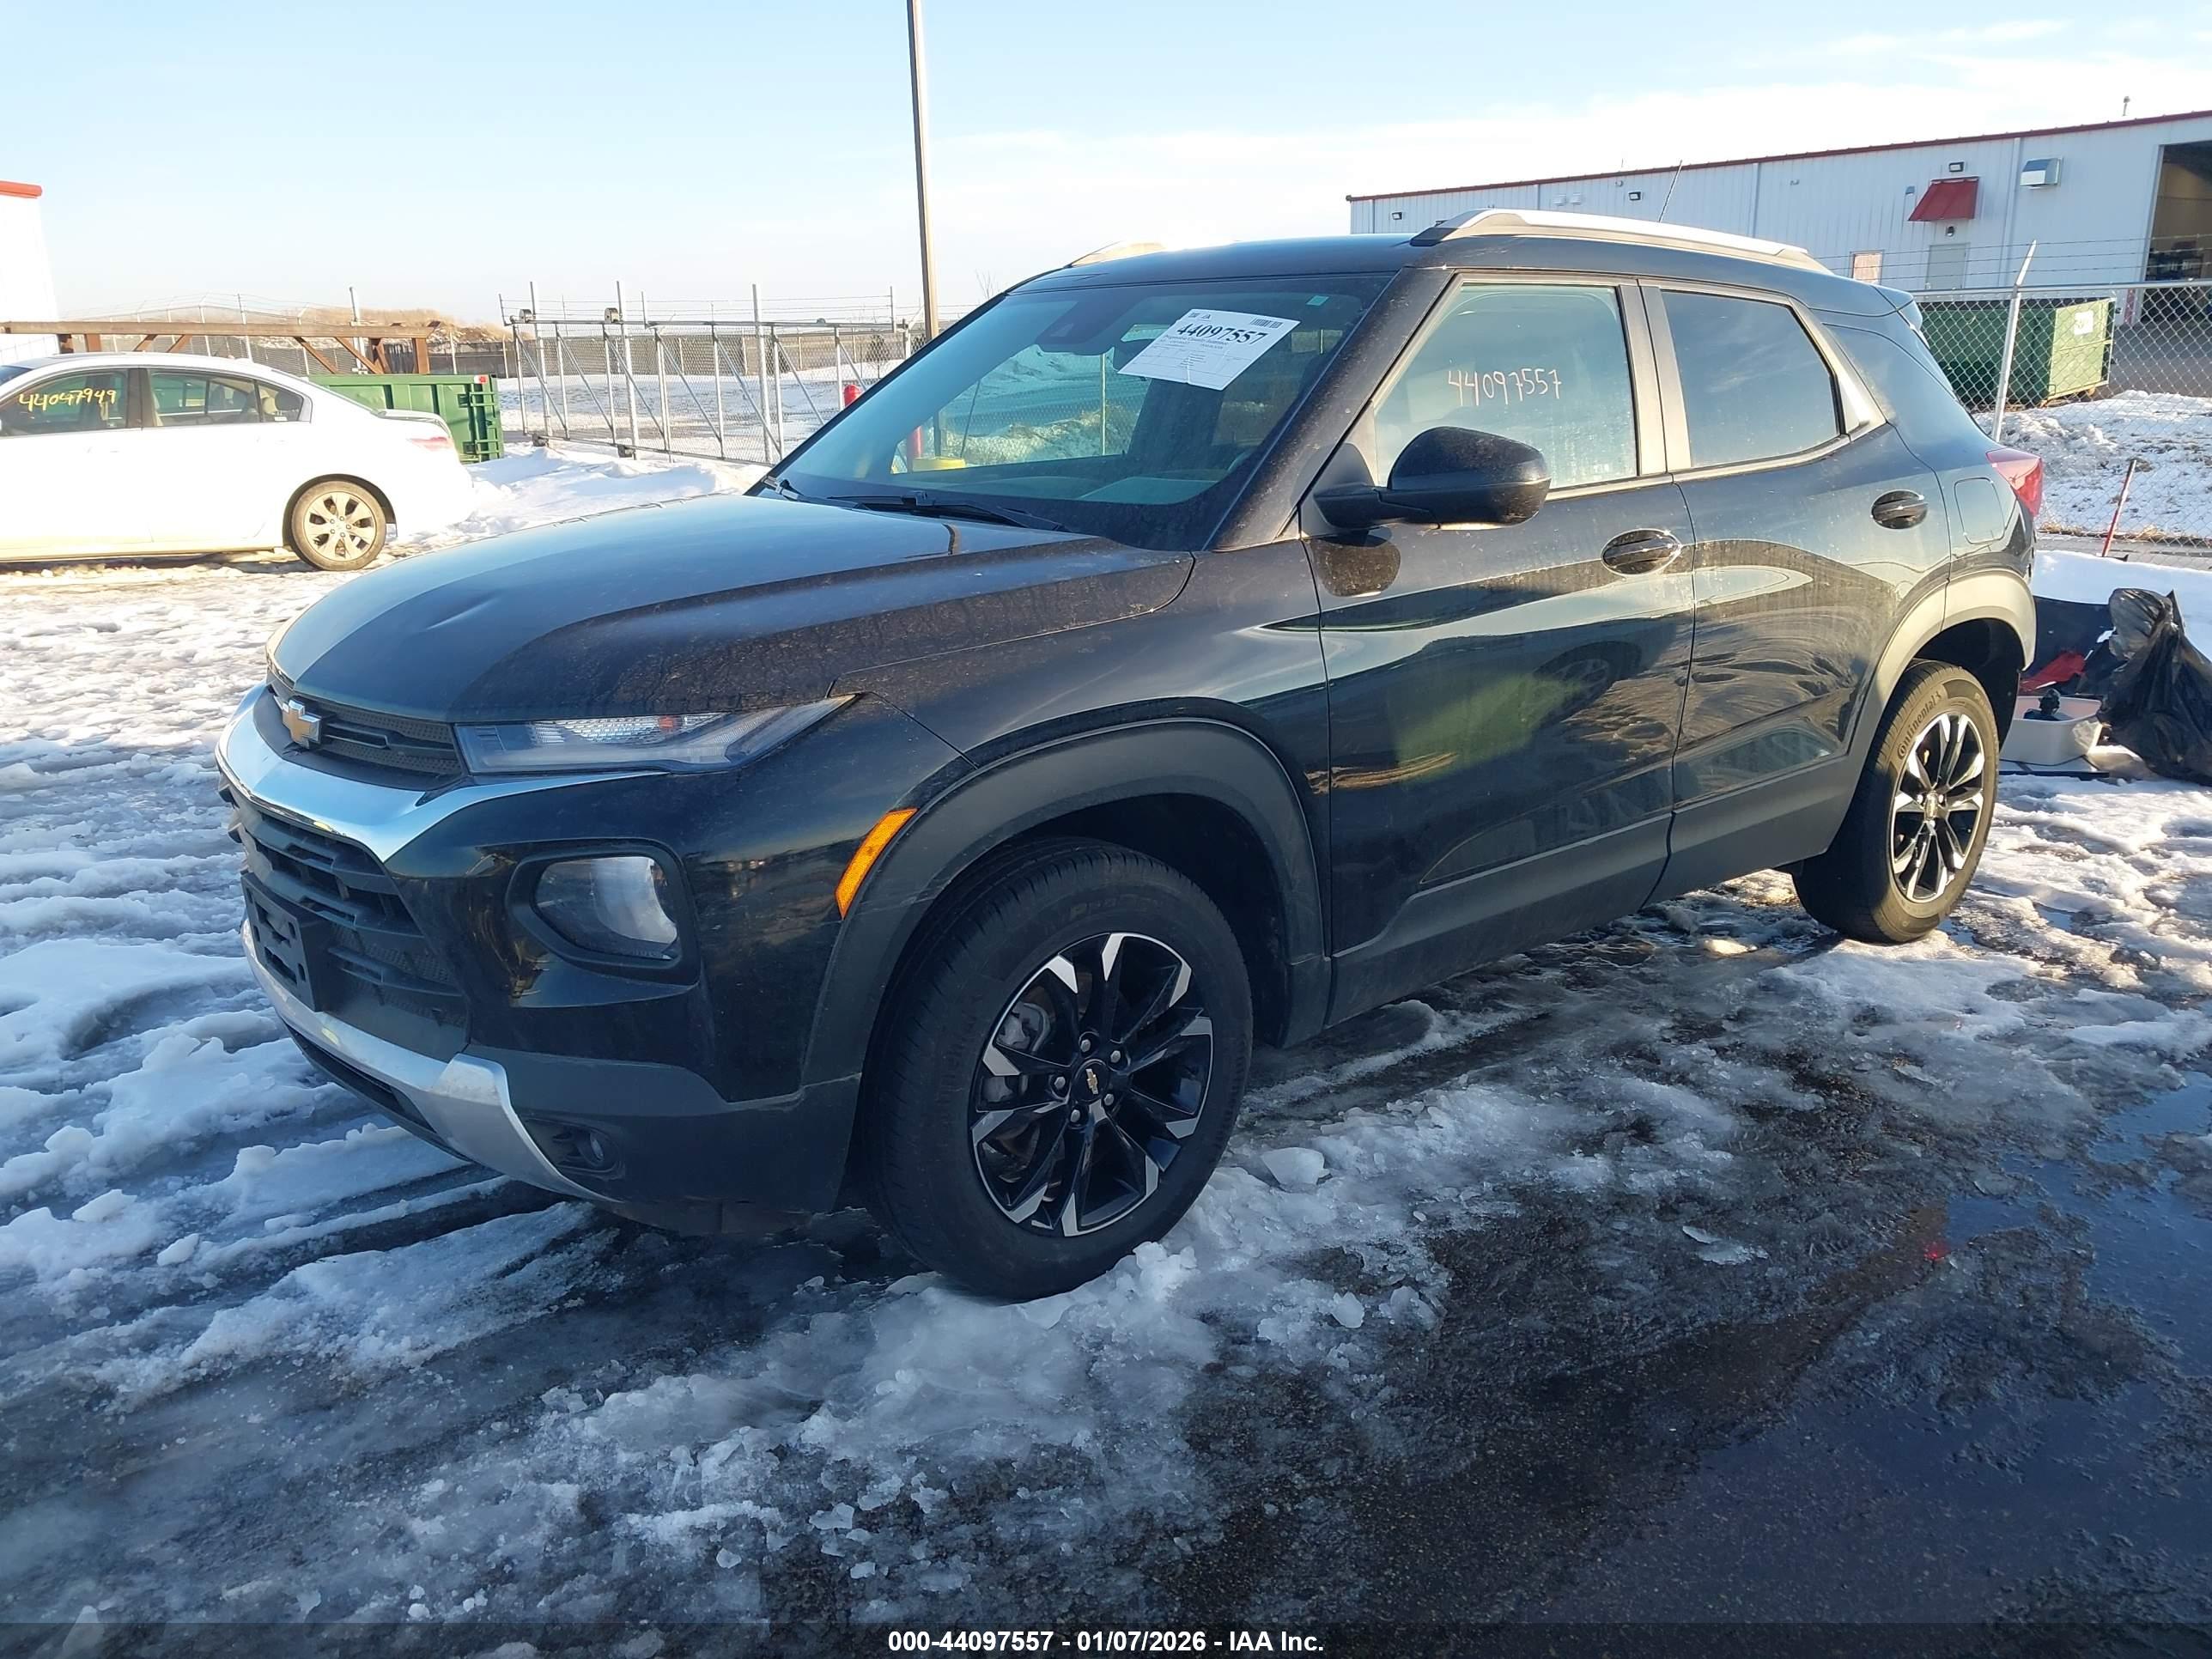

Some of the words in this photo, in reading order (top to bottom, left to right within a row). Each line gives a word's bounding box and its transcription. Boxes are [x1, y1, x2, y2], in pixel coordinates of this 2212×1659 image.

[1176, 323, 1268, 345] 44097557
[19, 387, 117, 412] 44047949
[1448, 368, 1563, 406] 44097557
[1897, 695, 1937, 761] Continental
